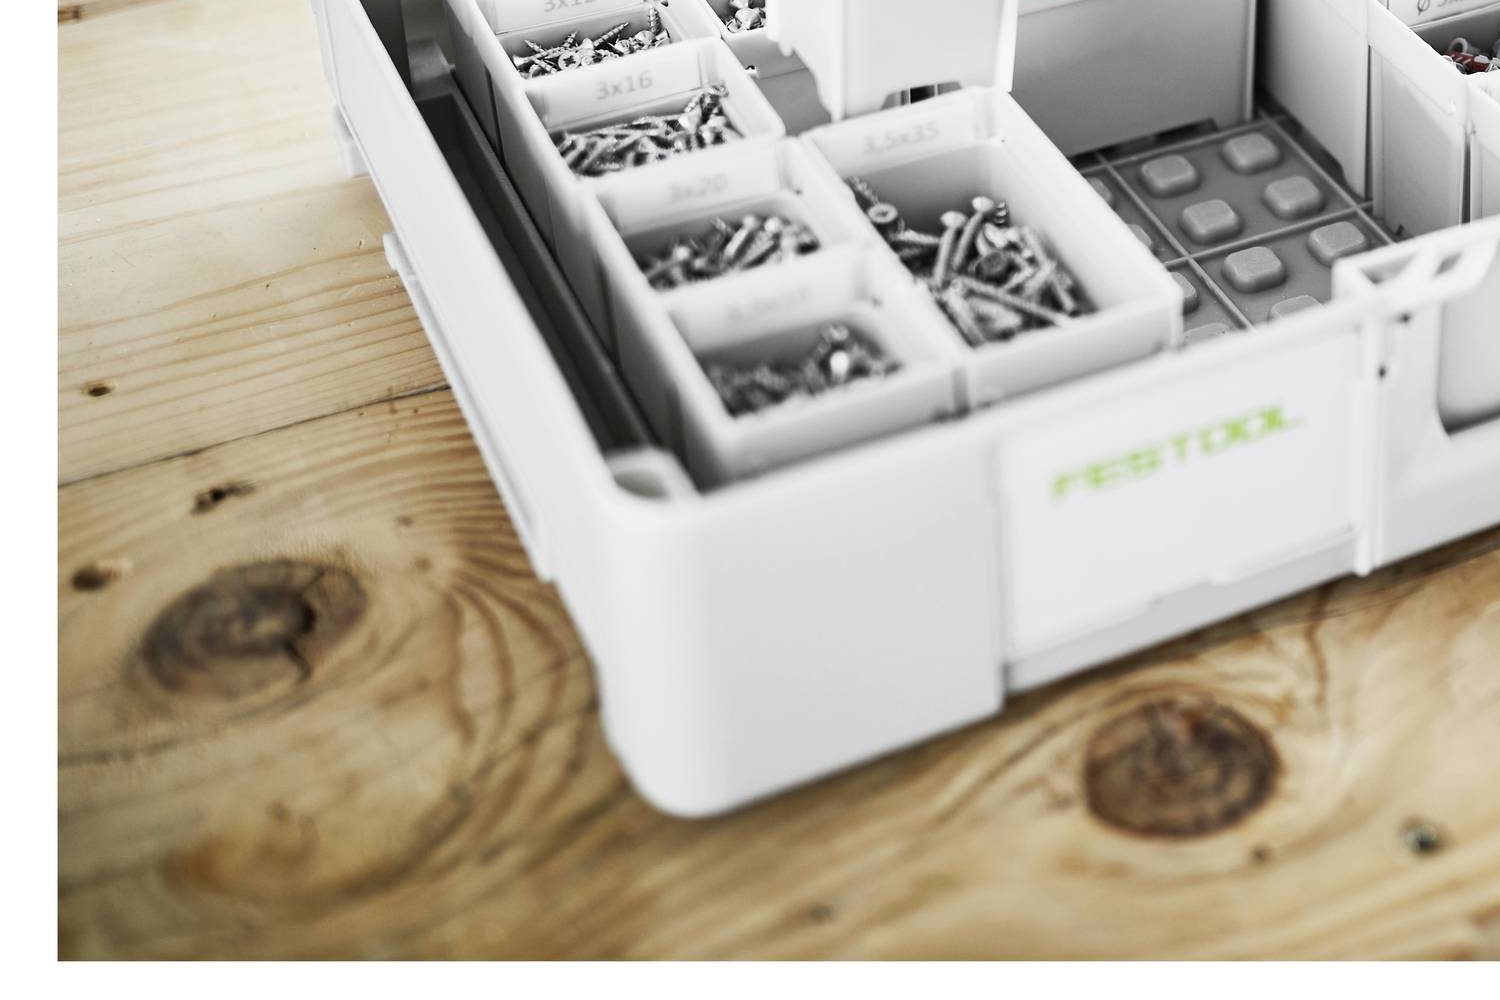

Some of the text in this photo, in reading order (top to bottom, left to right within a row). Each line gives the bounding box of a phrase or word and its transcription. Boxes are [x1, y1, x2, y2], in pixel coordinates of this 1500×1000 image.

[595, 70, 653, 100] 3x16
[862, 119, 940, 155] 3,5x35
[668, 173, 729, 202] 3x20
[1050, 402, 1307, 504] FESTOOL
